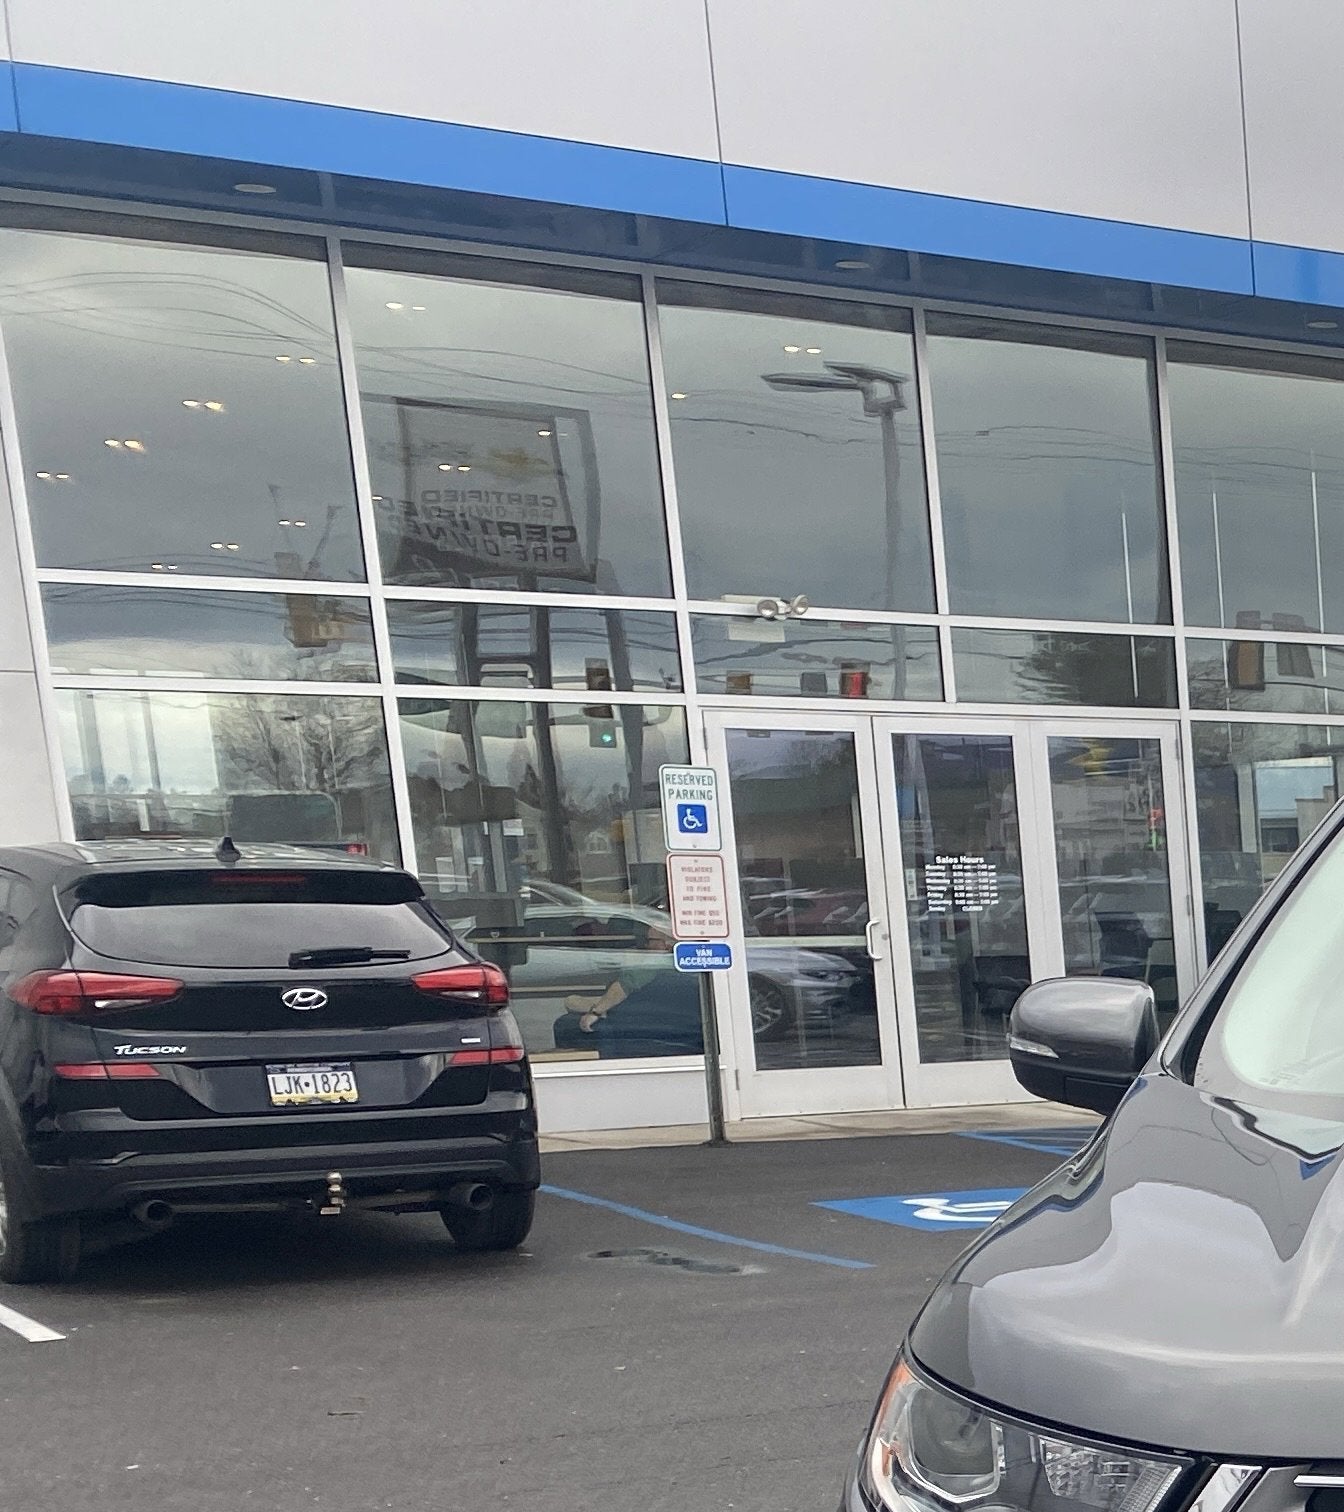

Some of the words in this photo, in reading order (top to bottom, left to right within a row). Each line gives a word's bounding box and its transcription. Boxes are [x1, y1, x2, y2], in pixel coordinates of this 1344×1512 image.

[665, 773, 713, 786] RESERVED
[668, 788, 713, 801] PARKING
[696, 949, 713, 957] VAN
[679, 956, 730, 966] ACCESSIBLE
[114, 1044, 187, 1055] TUCSON
